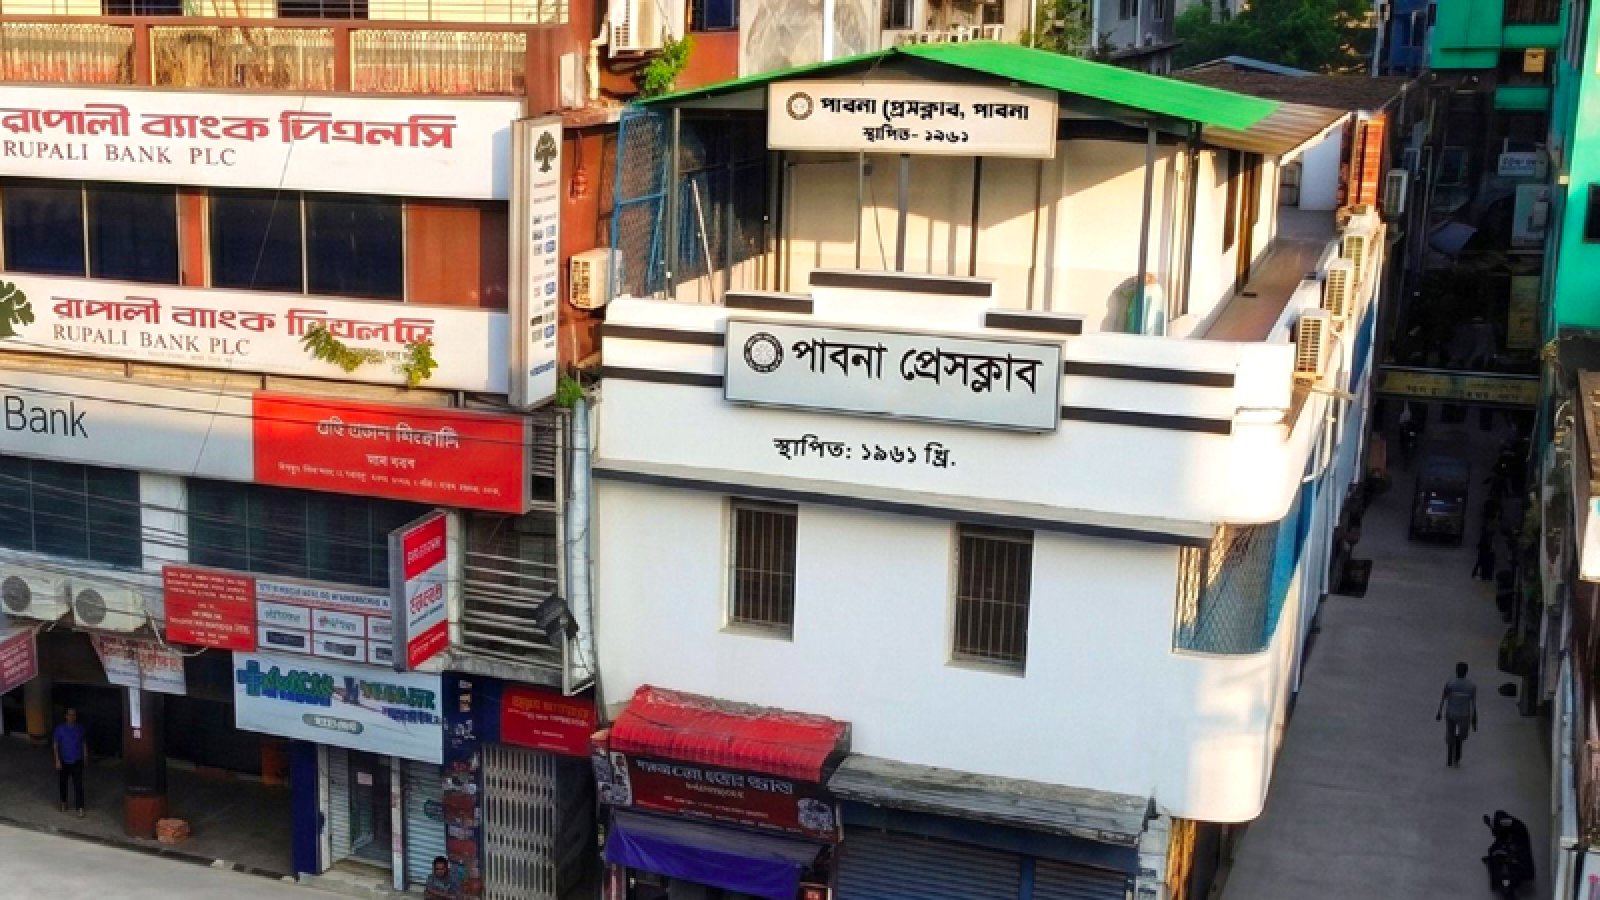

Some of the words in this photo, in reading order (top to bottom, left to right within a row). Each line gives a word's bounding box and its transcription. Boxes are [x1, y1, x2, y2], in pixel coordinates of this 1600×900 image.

[820, 97, 877, 115] পাবনা
[972, 103, 1030, 121] পাবনা
[141, 113, 270, 142] ব্যাংক
[3, 139, 88, 162] RUPALI
[104, 143, 173, 164] BANK
[189, 147, 237, 167] PLC
[53, 323, 128, 346] RUPALI
[139, 331, 200, 353] BANK
[209, 337, 251, 356] PLC
[791, 337, 889, 380] পাবনা
[901, 346, 1043, 394] প্রেসক্লাব
[4, 394, 89, 439] Bank
[773, 433, 851, 461] স্থাপিত:
[861, 443, 917, 464] ১৯৬১
